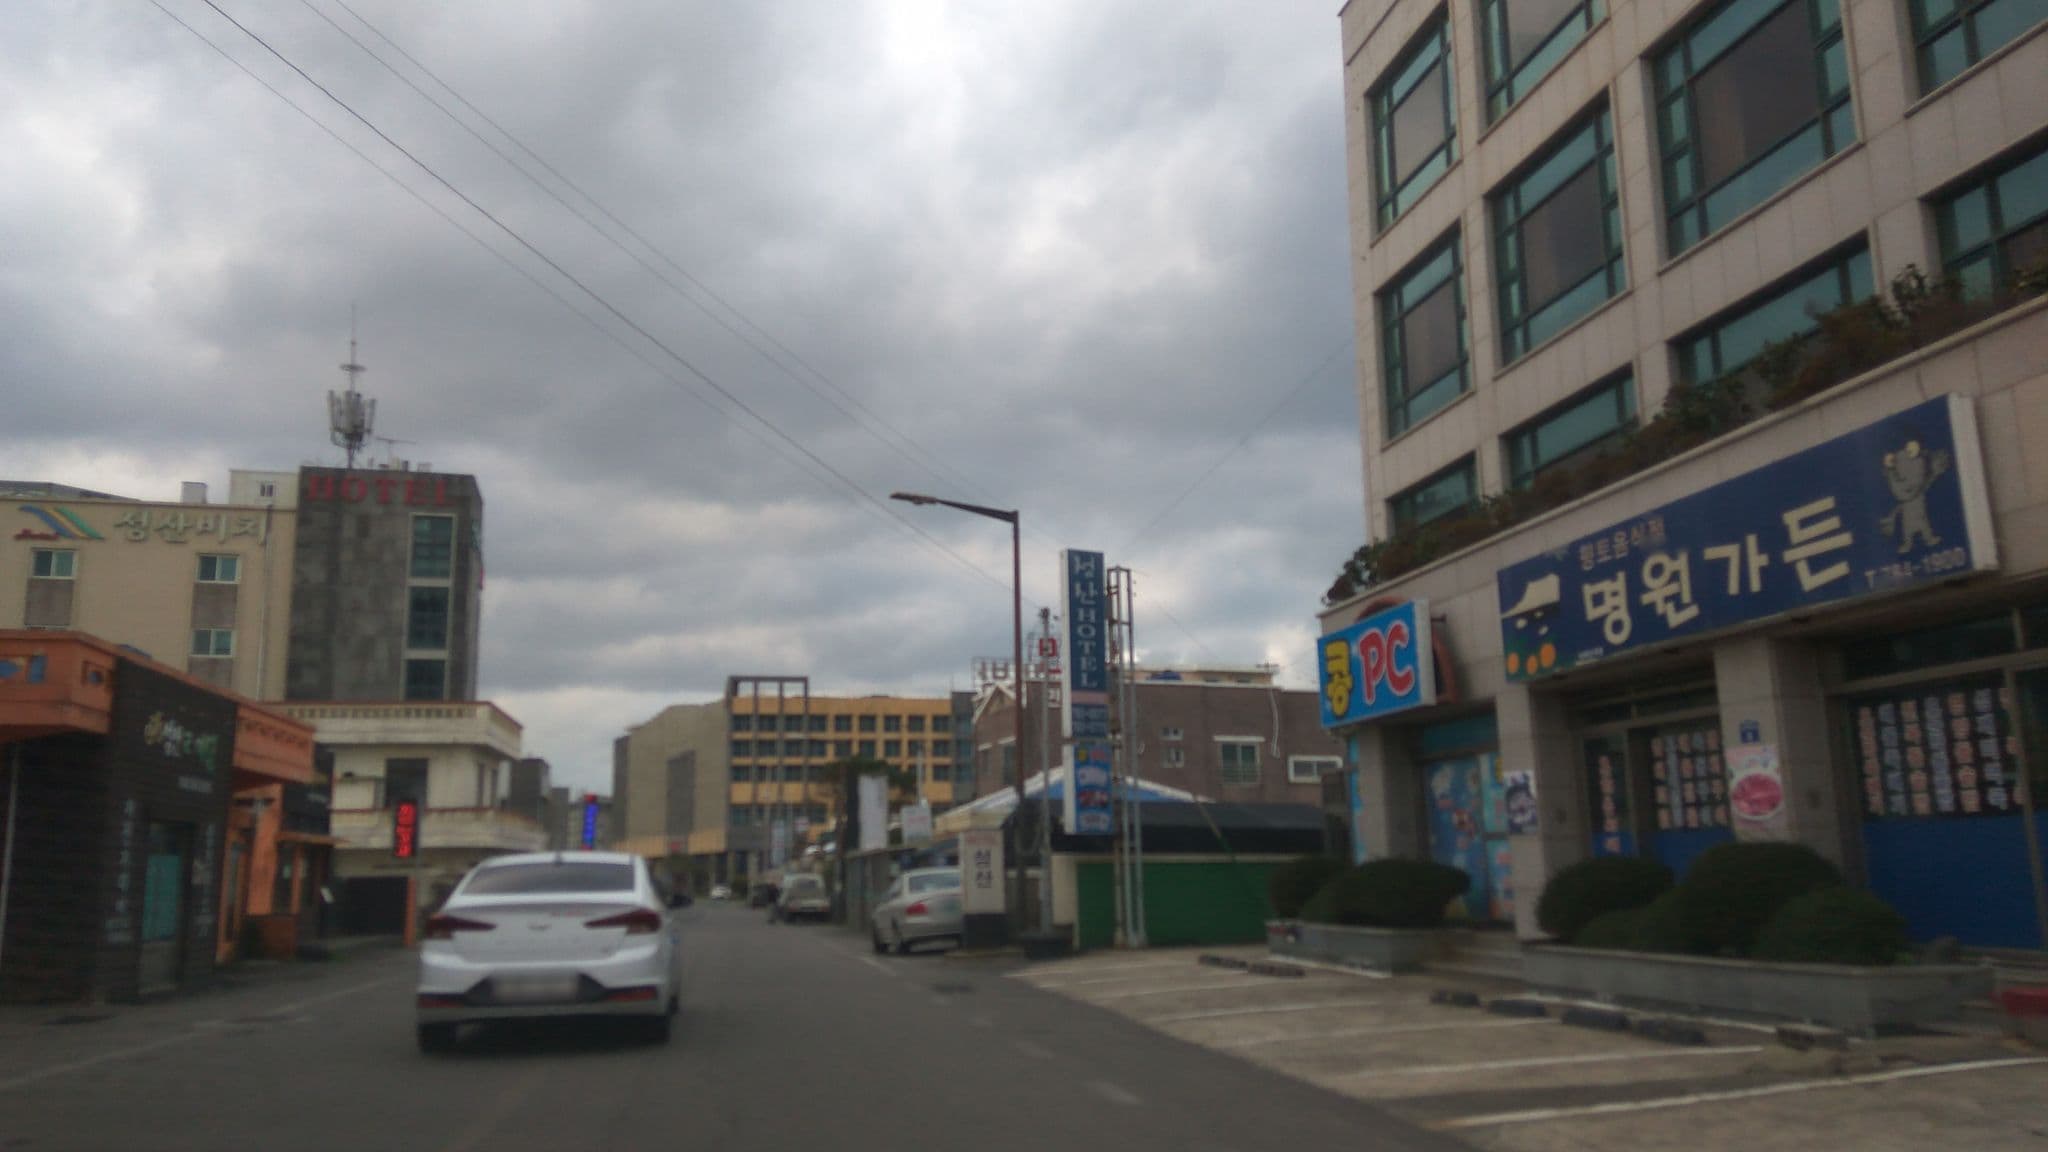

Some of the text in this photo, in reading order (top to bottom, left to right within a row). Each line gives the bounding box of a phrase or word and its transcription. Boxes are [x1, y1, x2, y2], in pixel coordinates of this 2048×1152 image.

[307, 474, 455, 506] HOTEL
[113, 508, 267, 546] 성산비치
[1581, 496, 1853, 646] 명원가든
